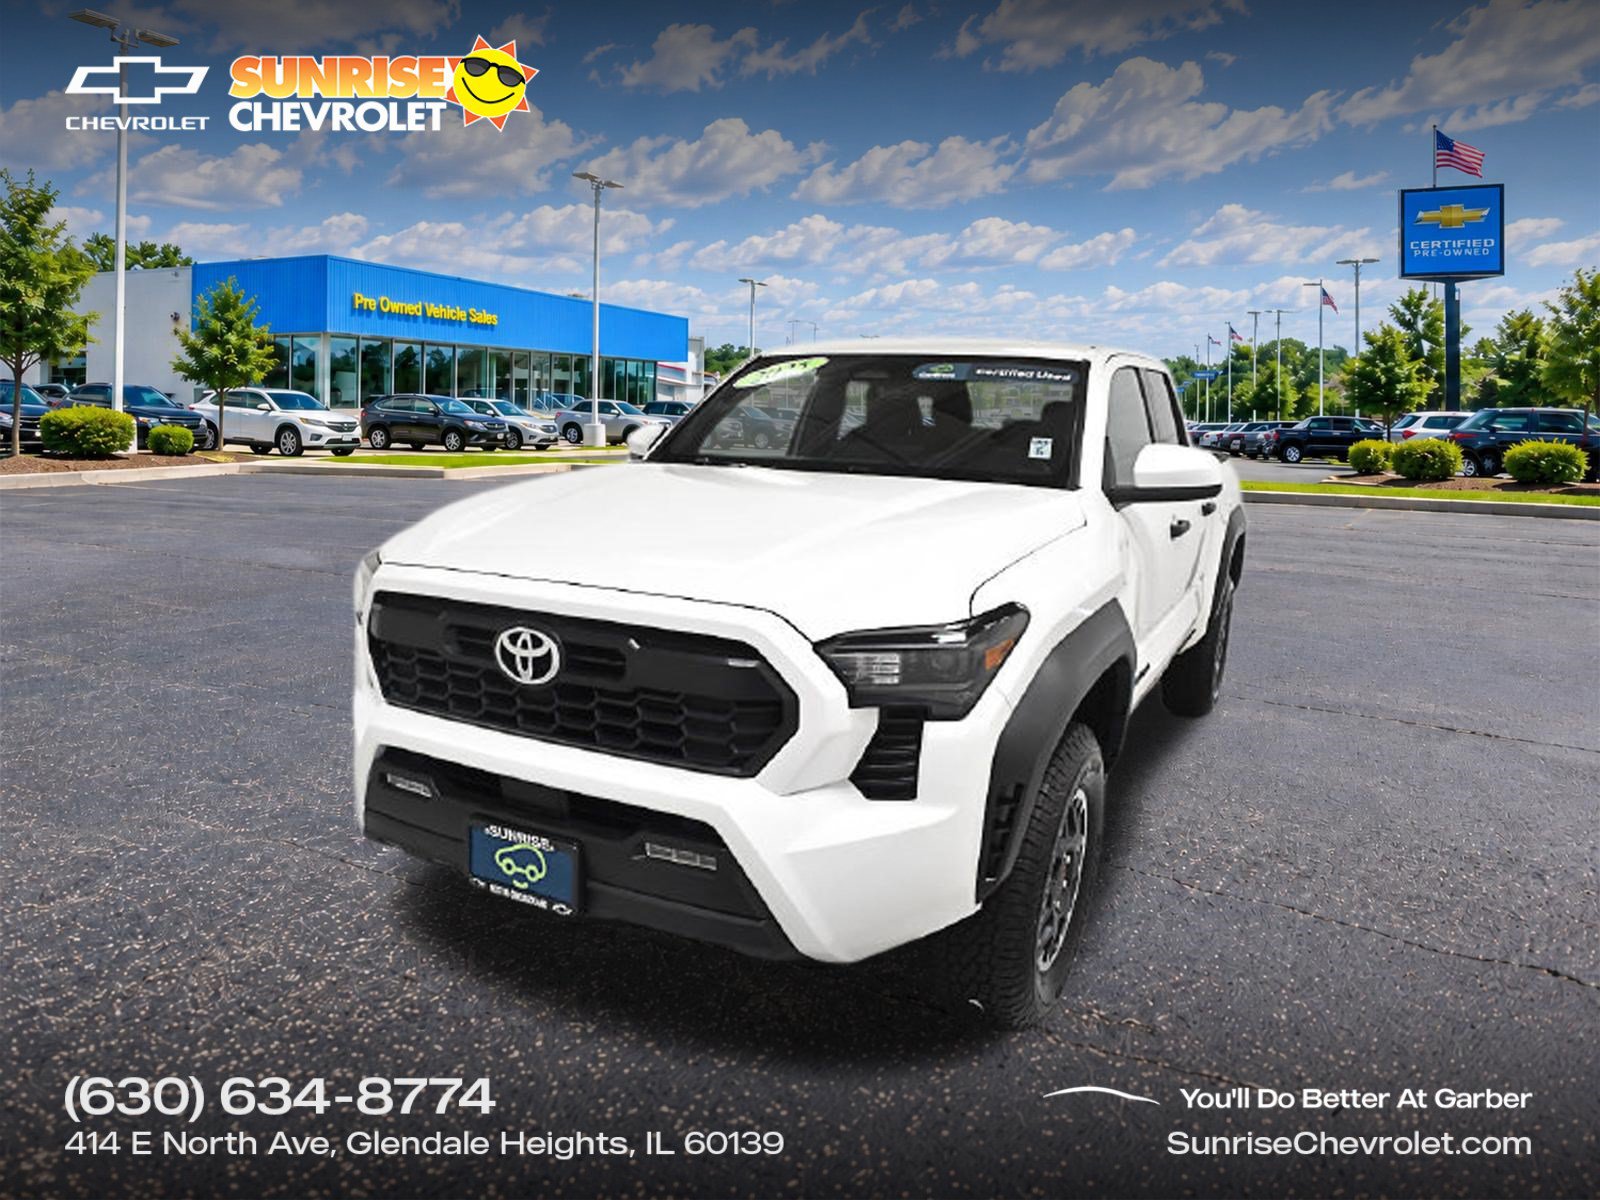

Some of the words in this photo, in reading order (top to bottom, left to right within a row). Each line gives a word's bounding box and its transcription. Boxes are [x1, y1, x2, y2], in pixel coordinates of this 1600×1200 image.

[1410, 238, 1496, 250] CERTIFIED
[1413, 247, 1490, 257] PRE-OWNED
[353, 292, 377, 311] Pre
[379, 296, 422, 317] Owned
[425, 302, 467, 322] Vehicle
[468, 307, 498, 326] Sales
